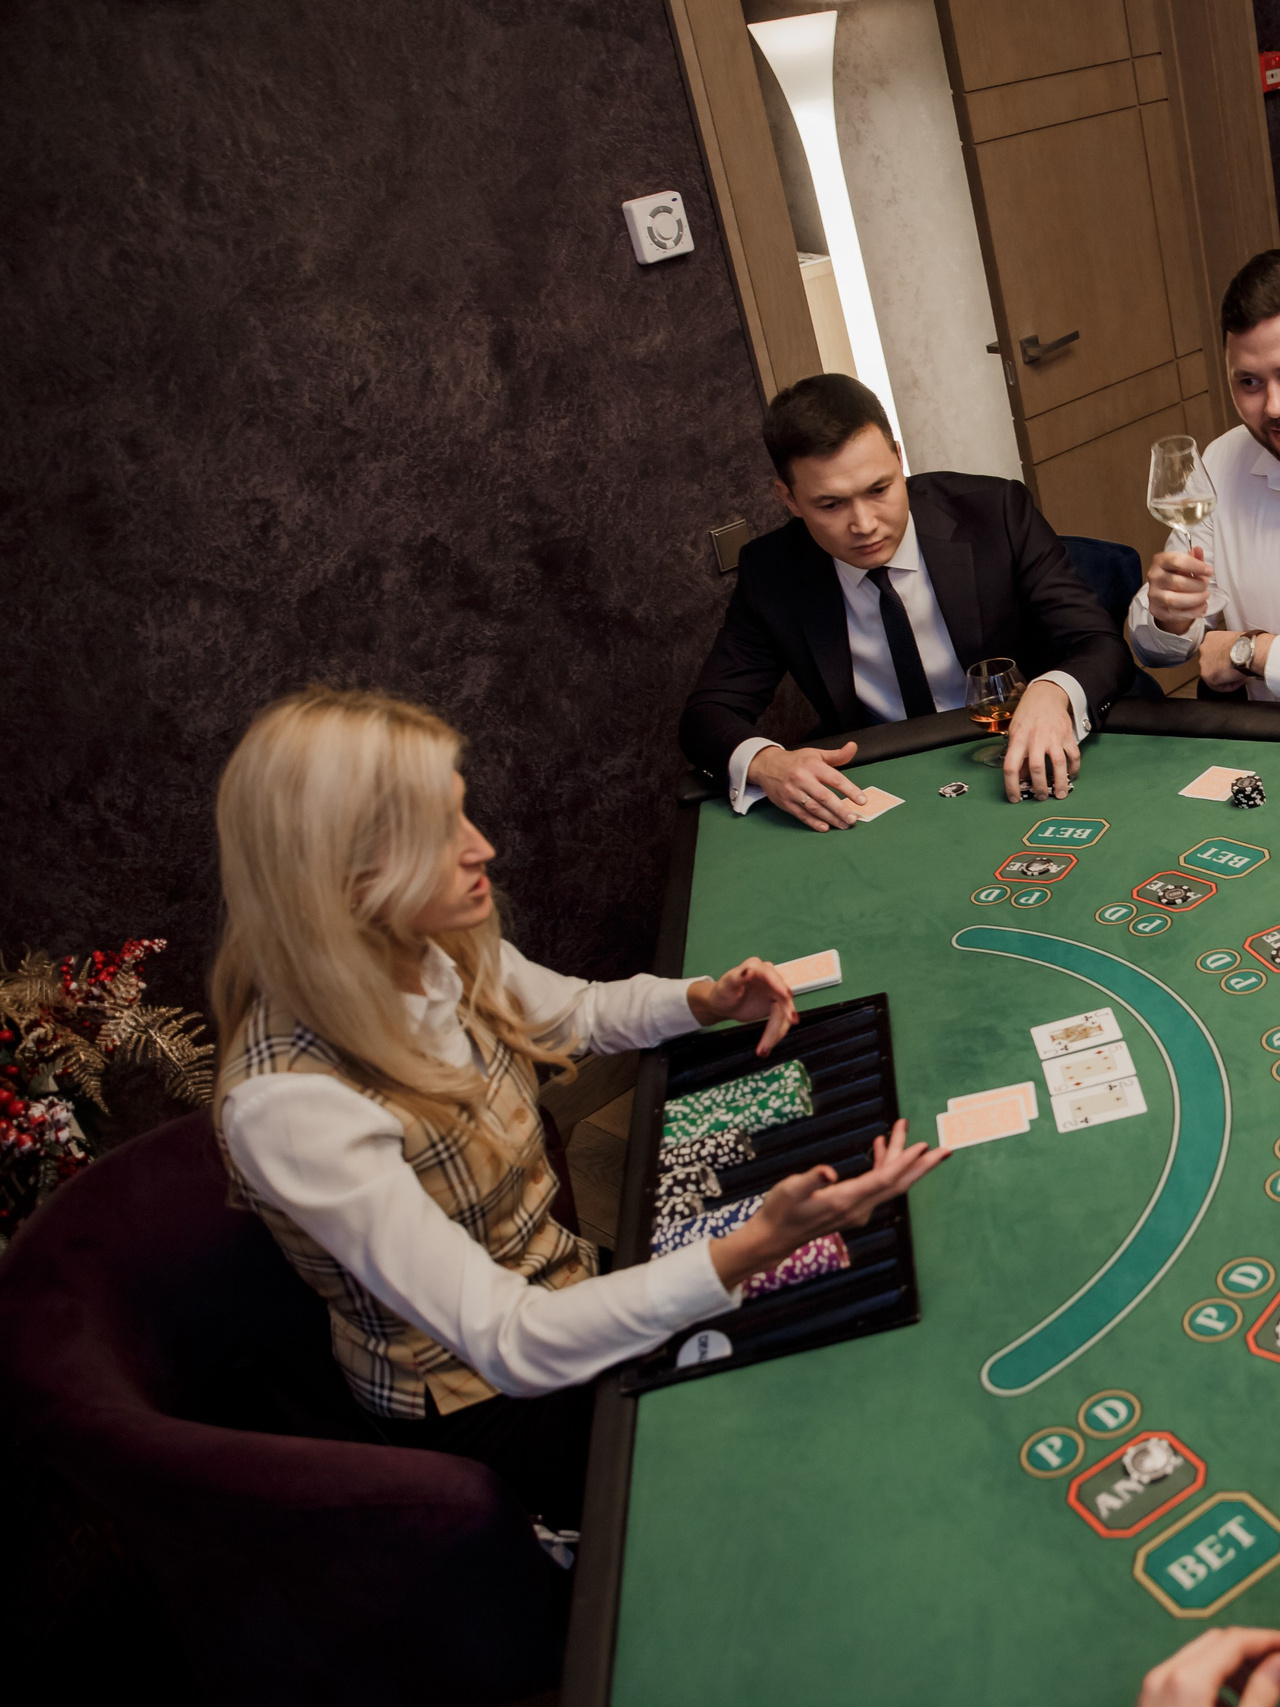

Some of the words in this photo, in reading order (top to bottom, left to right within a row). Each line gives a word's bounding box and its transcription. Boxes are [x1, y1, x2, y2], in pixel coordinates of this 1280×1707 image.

[1038, 826, 1094, 839] BET
[1197, 847, 1252, 869] BET
[1006, 861, 1066, 874] AE
[979, 888, 1002, 901] D
[1019, 891, 1042, 904] P
[1103, 907, 1129, 921] D
[1137, 919, 1163, 932] P
[1206, 953, 1233, 969] D
[1229, 975, 1258, 990] P
[1228, 1264, 1264, 1290] D
[1194, 1306, 1227, 1332] P
[1092, 1399, 1129, 1429] D
[1034, 1435, 1063, 1468] P
[1166, 1515, 1256, 1591] BET
